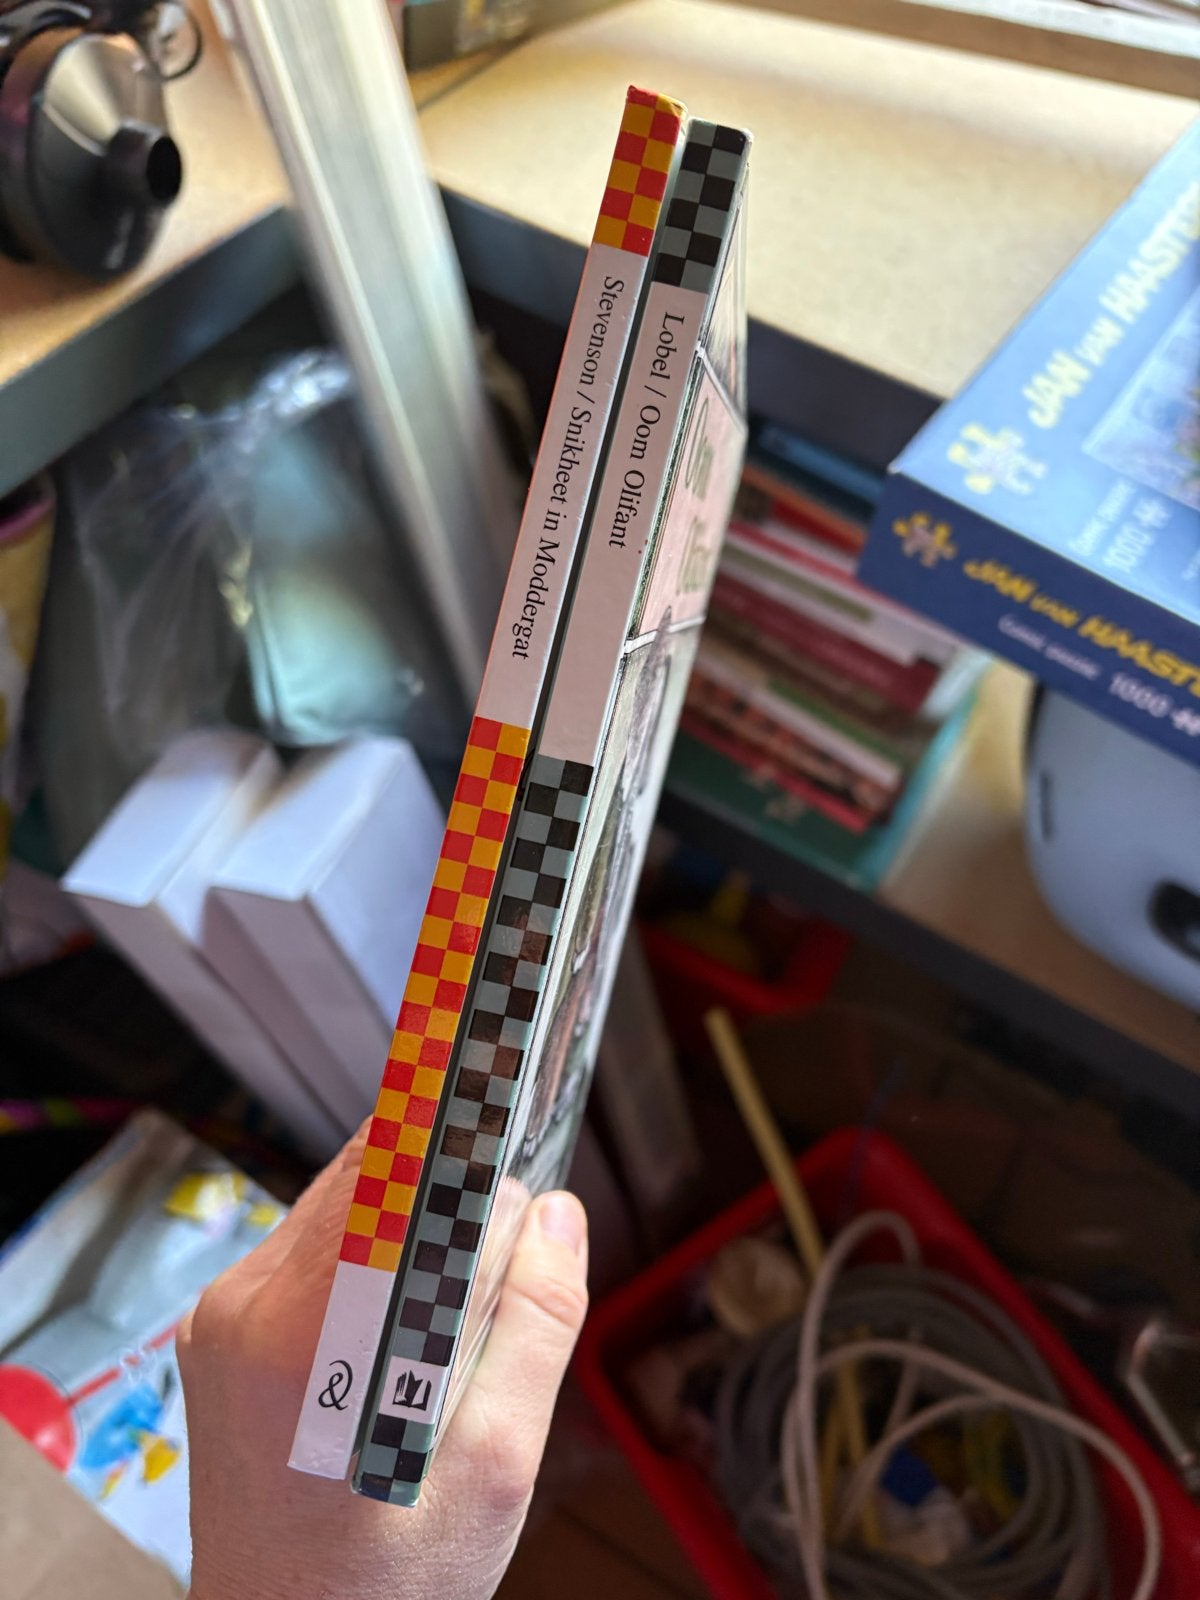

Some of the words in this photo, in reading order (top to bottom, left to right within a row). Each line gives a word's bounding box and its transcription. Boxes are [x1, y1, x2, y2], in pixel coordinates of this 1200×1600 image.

[580, 275, 625, 386] Stevenson
[650, 311, 685, 381] Lobel
[1022, 351, 1092, 429] JAN
[550, 406, 592, 505] Snikheet
[629, 404, 662, 461] Oom
[543, 509, 568, 532] in
[608, 468, 646, 549] Olifant
[512, 536, 561, 661] Moddergat
[963, 559, 1037, 603] JAN
